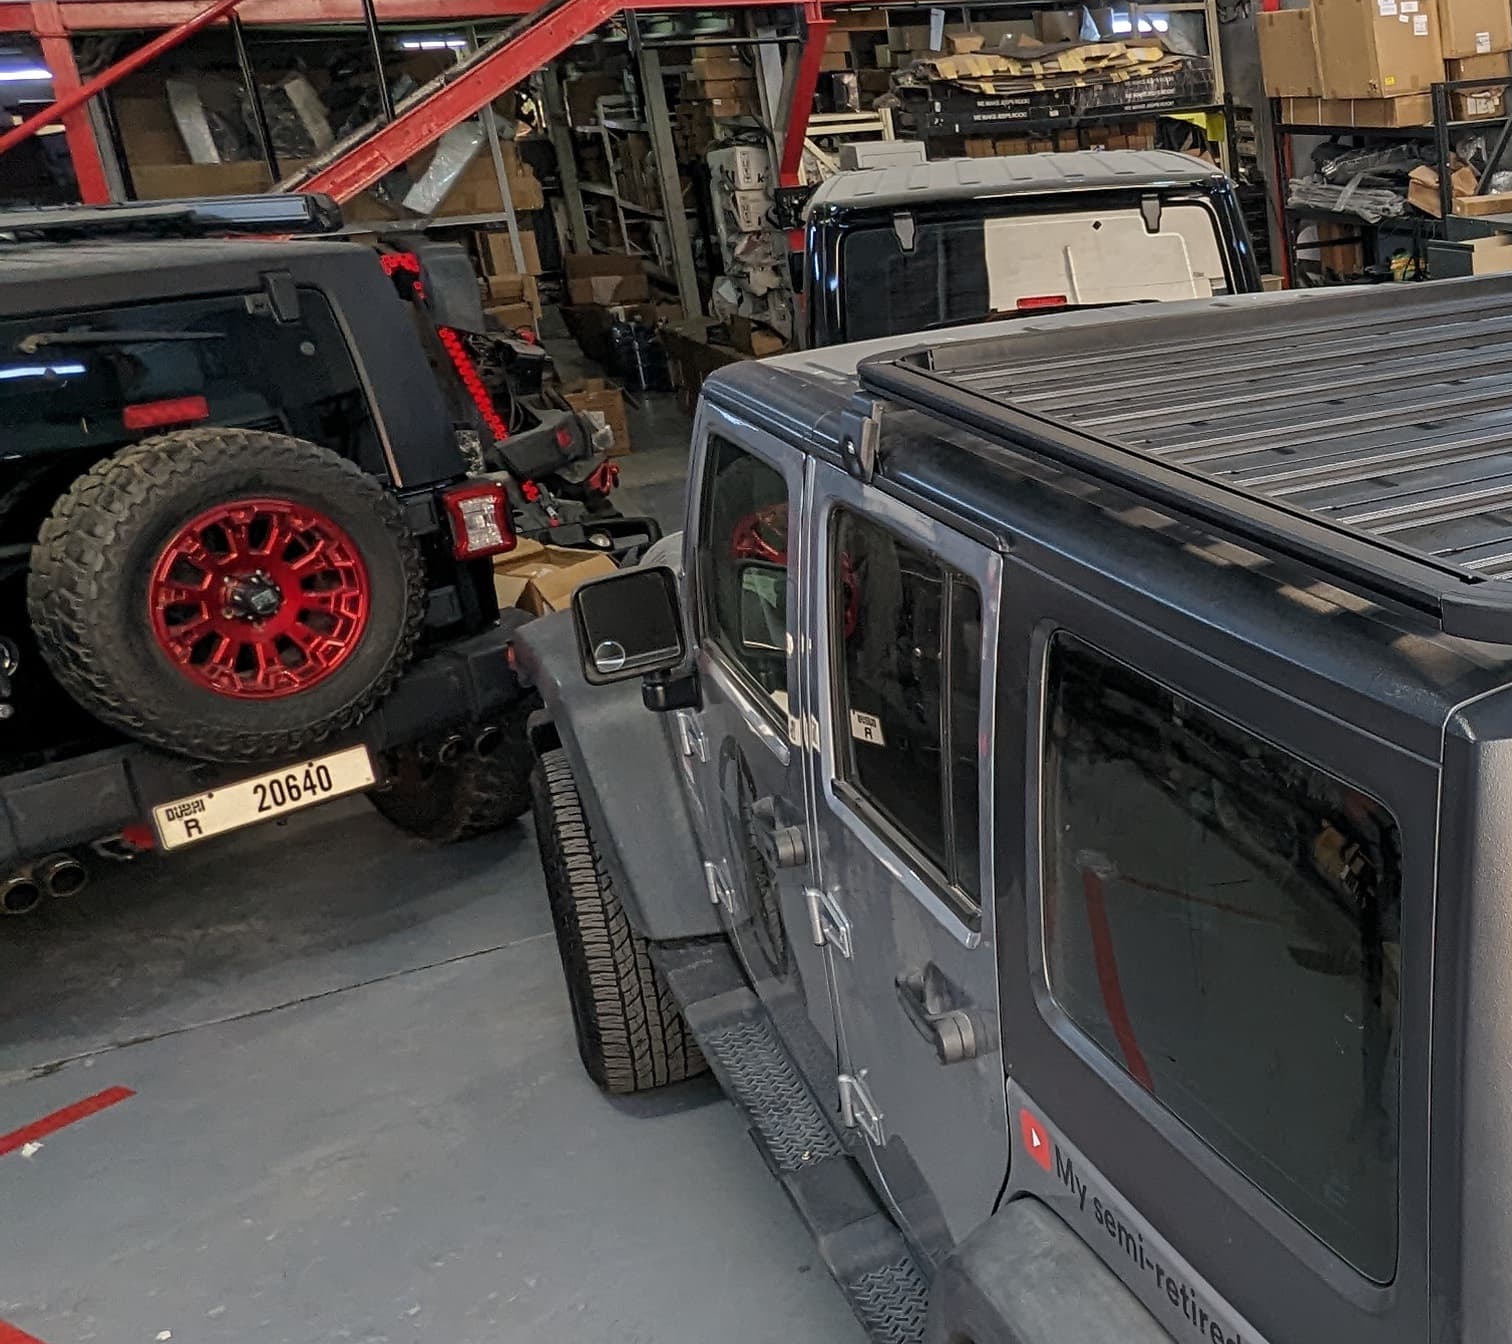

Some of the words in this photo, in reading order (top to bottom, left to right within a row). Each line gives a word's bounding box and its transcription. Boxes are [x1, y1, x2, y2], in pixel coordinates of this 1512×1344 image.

[253, 764, 333, 813] 20640
[183, 818, 203, 838] R
[1055, 1143, 1087, 1211] My
